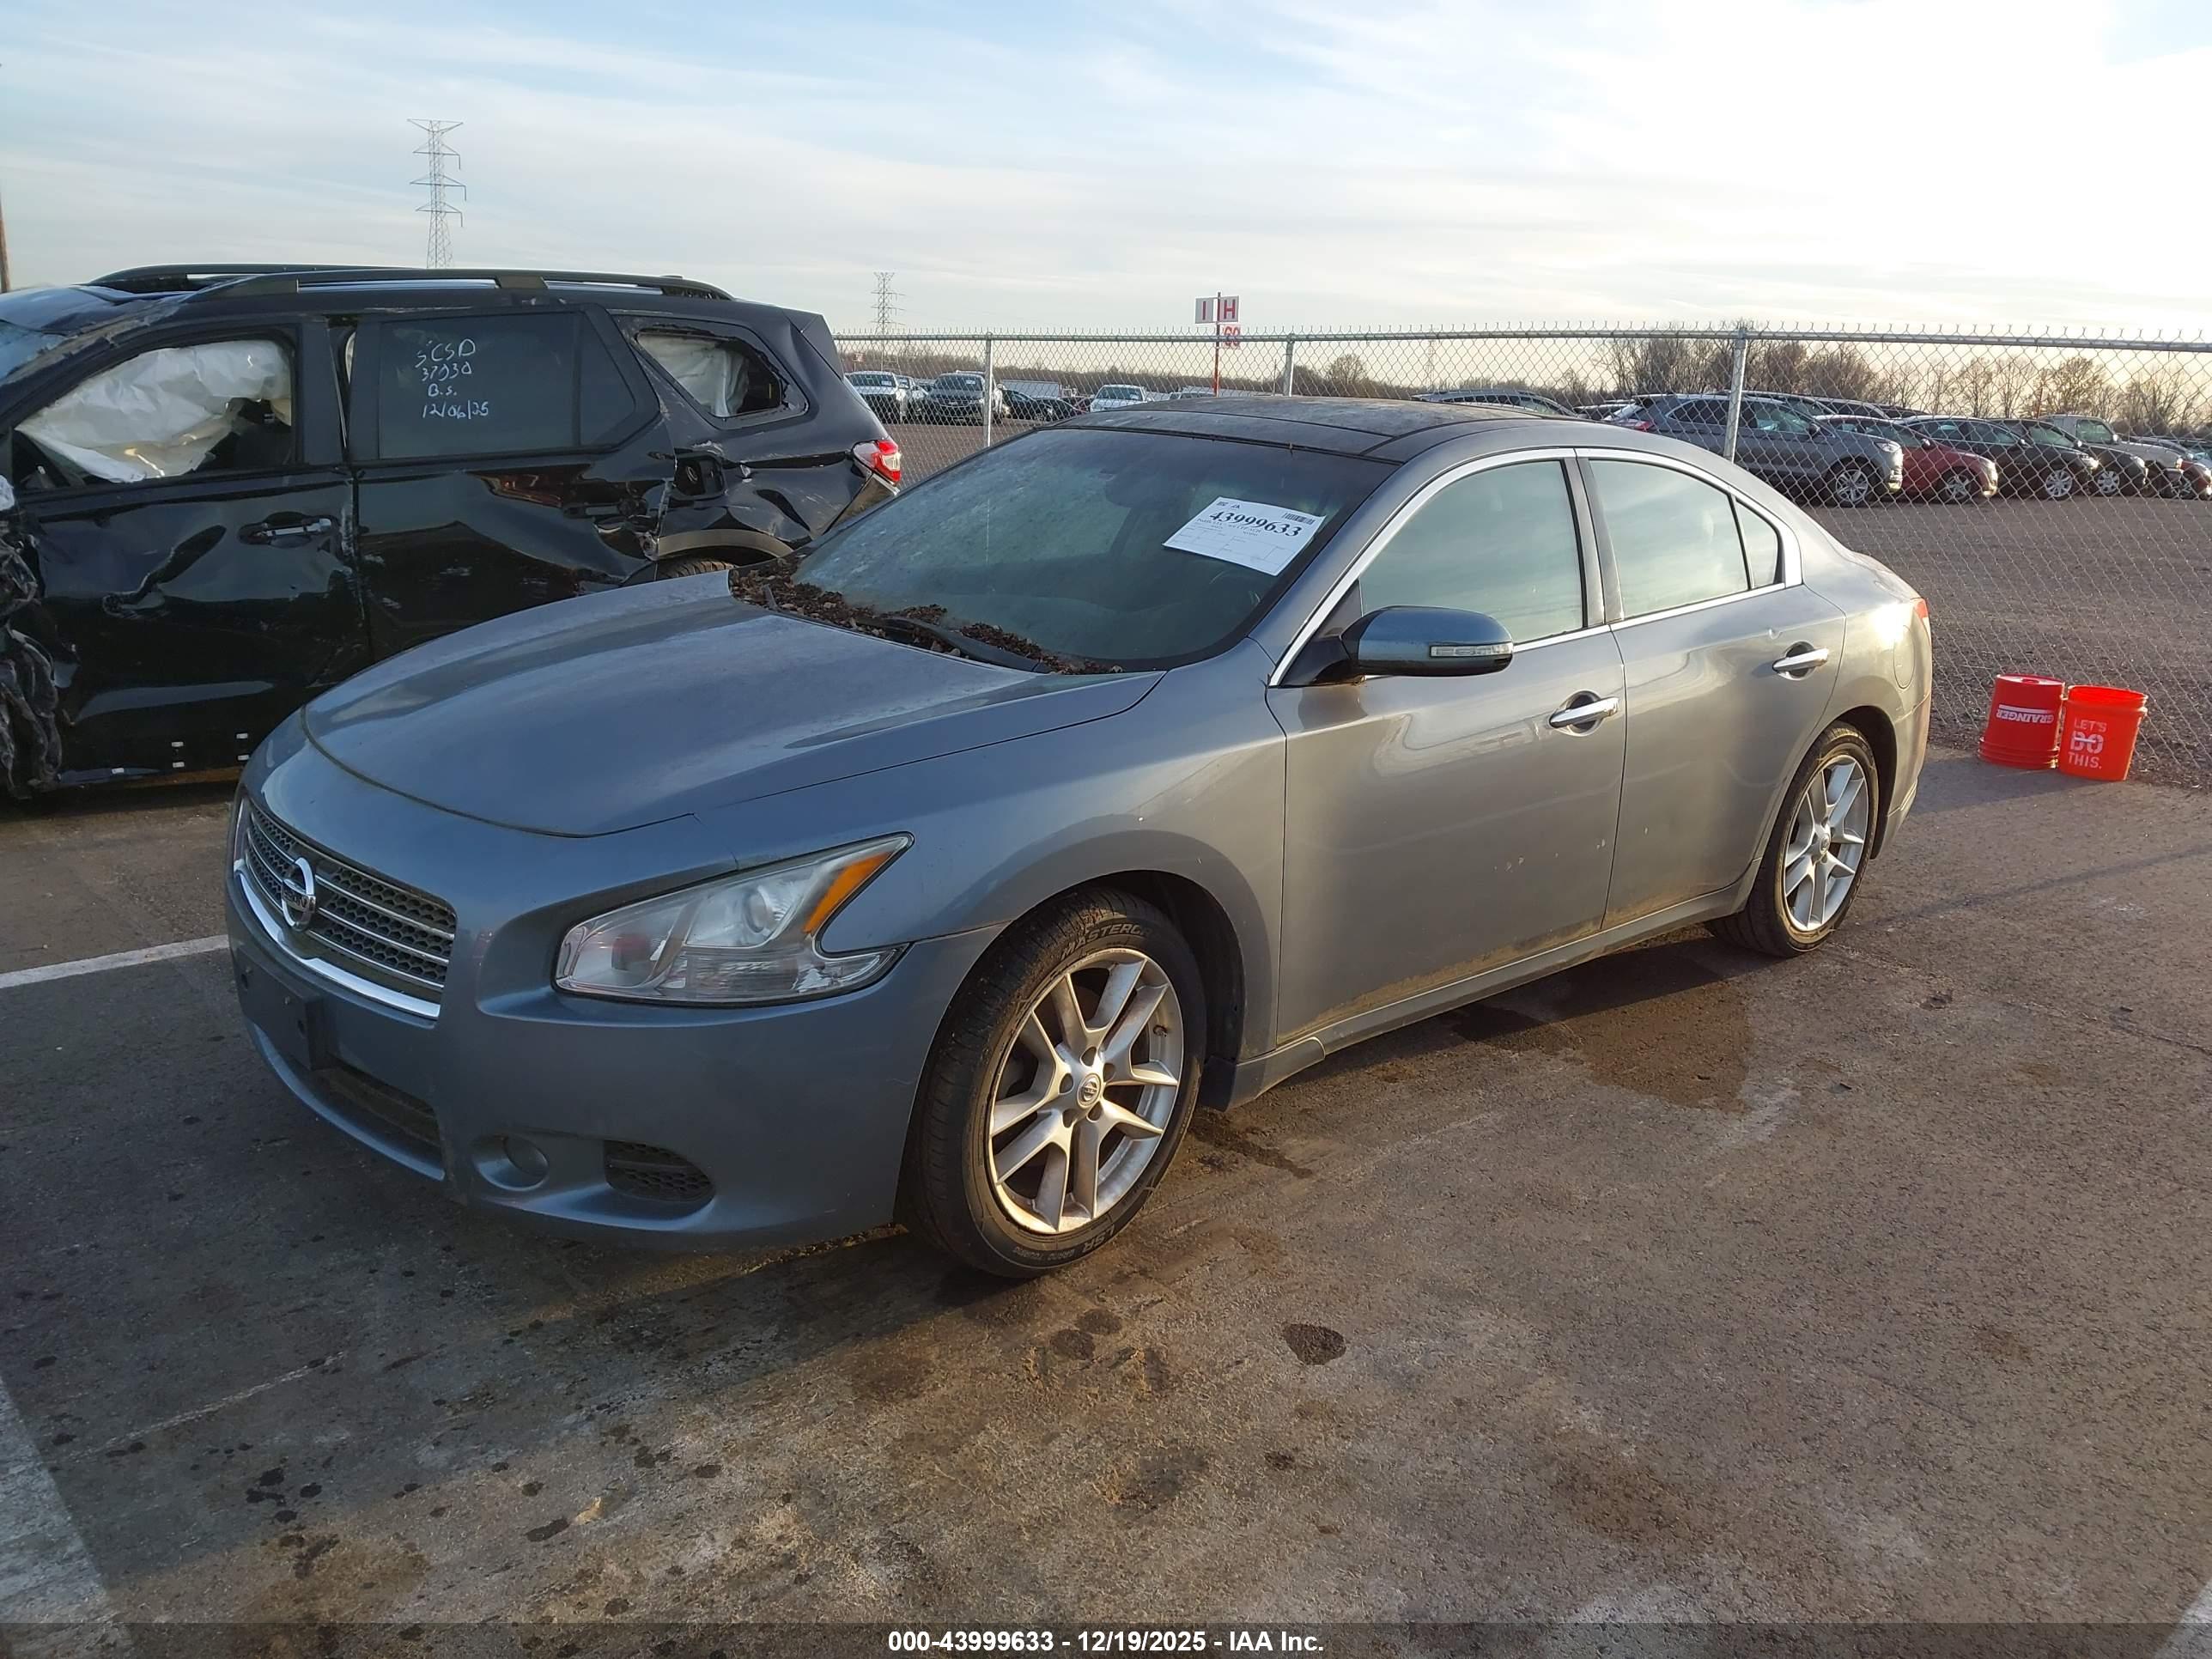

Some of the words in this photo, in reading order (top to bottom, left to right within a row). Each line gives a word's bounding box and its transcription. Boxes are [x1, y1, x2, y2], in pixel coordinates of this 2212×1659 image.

[1223, 298, 1236, 320] H
[1208, 511, 1303, 538] 43999633
[1996, 708, 2055, 724] GRAINGER
[2074, 718, 2107, 732] LET'S
[2070, 731, 2104, 754] DO
[2068, 751, 2102, 769] THIS.
